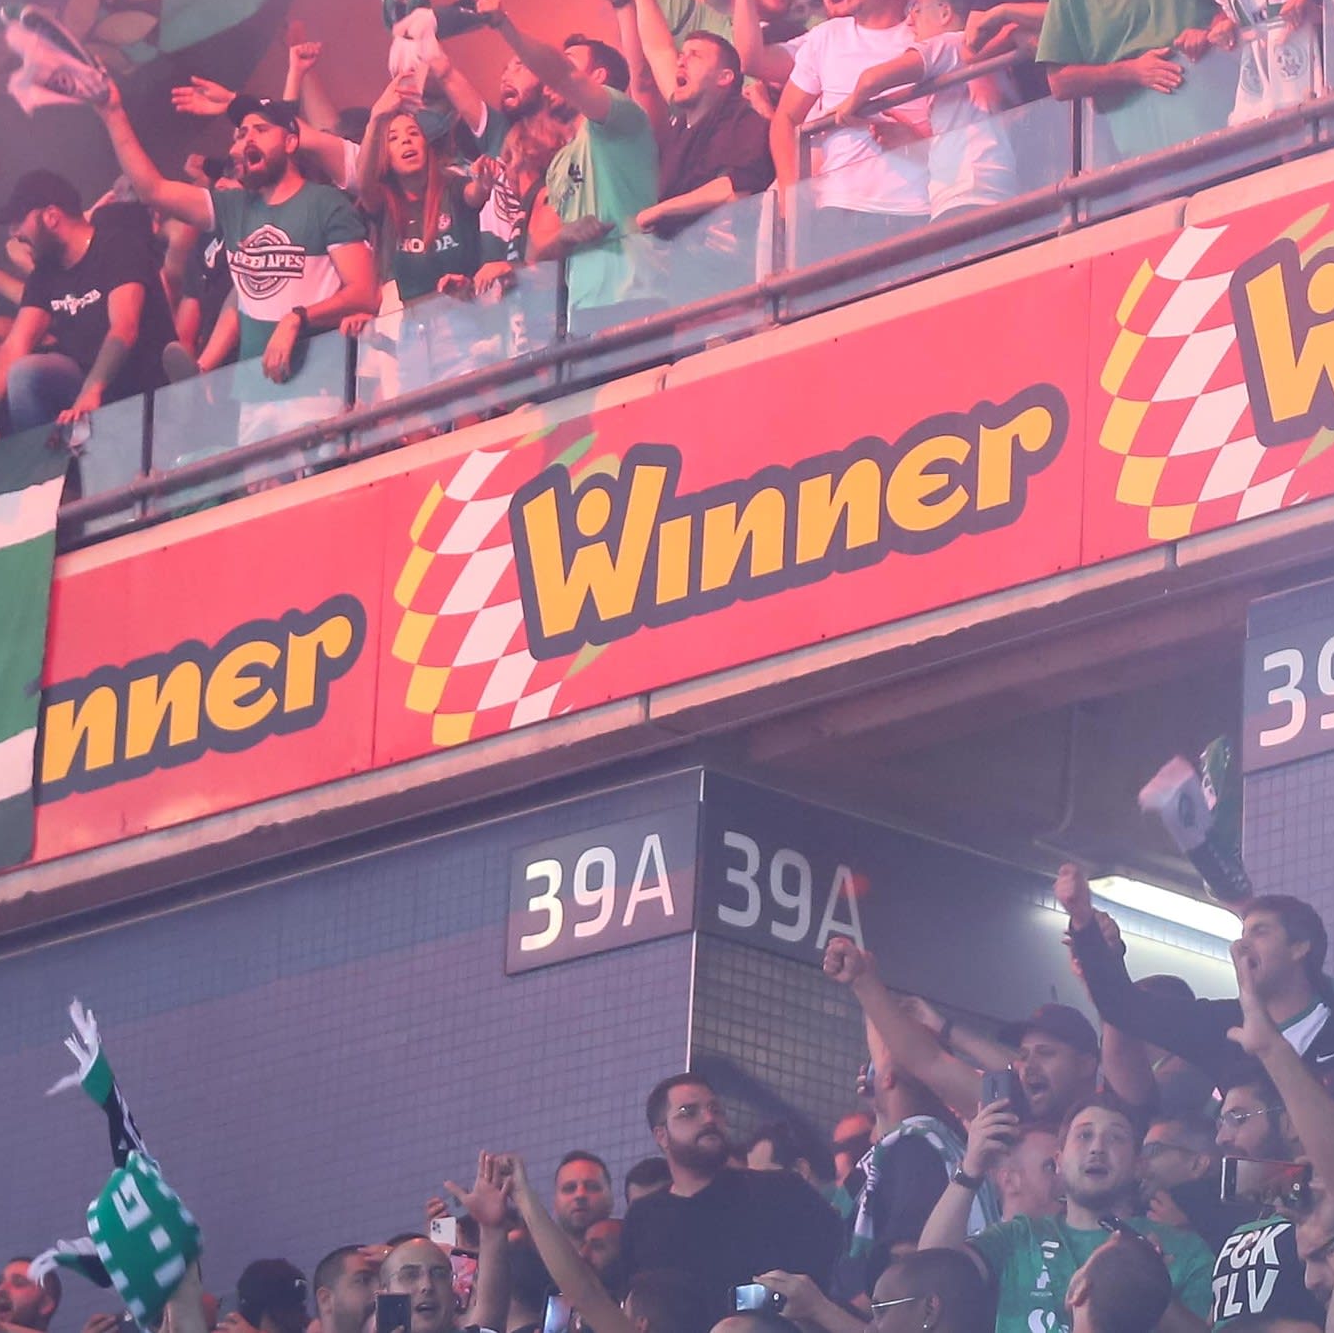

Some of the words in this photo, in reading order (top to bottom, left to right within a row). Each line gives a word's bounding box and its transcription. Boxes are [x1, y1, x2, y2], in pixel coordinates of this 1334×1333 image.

[269, 252, 306, 269] APES
[523, 407, 1053, 637] Winner
[41, 615, 353, 784] nner
[520, 833, 675, 952] 39A
[718, 830, 866, 955] 39A
[1212, 1222, 1292, 1277] FCK
[1212, 1268, 1280, 1322] TLV
